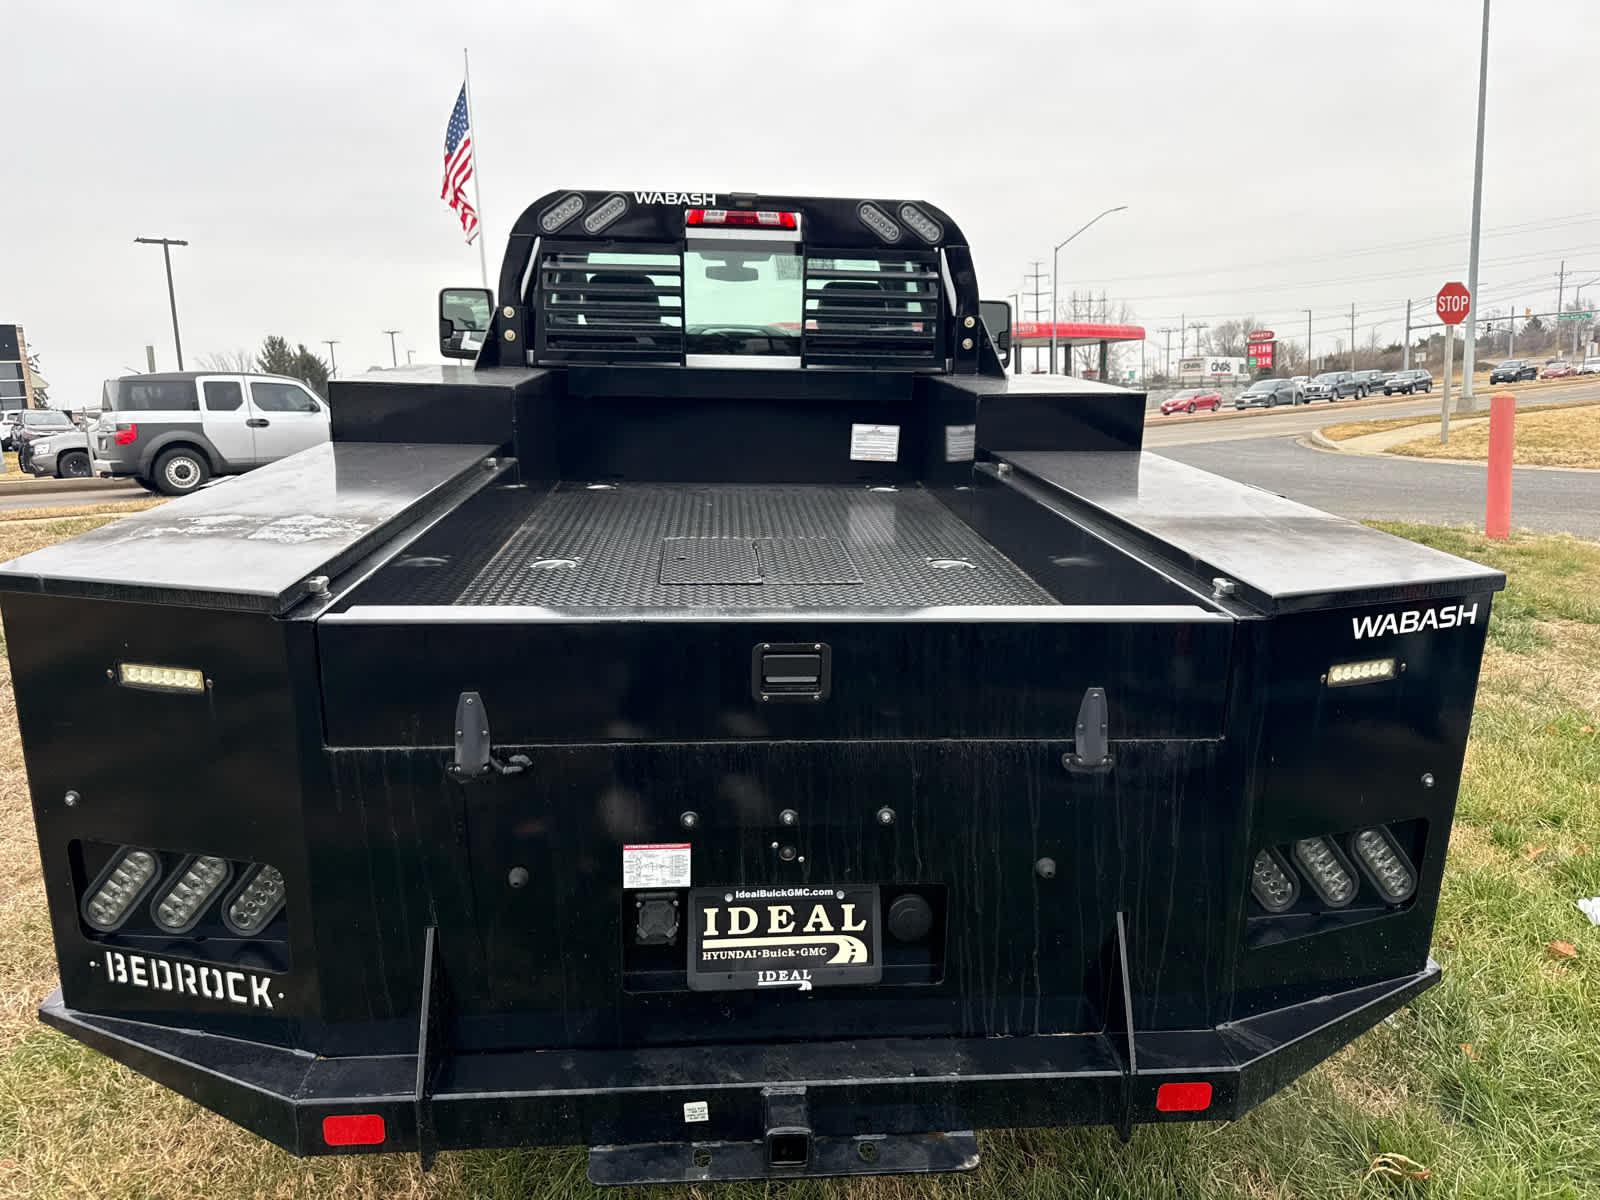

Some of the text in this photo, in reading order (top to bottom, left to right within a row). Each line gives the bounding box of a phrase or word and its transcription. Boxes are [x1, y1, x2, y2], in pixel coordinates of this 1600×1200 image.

[634, 191, 716, 206] WABASH
[1438, 295, 1469, 312] STOP
[1352, 603, 1478, 639] WABASH
[735, 888, 834, 899] IdealBuickGMC.com
[703, 903, 867, 936] IDEAL
[105, 951, 273, 1008] BEDROCK
[758, 969, 812, 982] IDEAL
